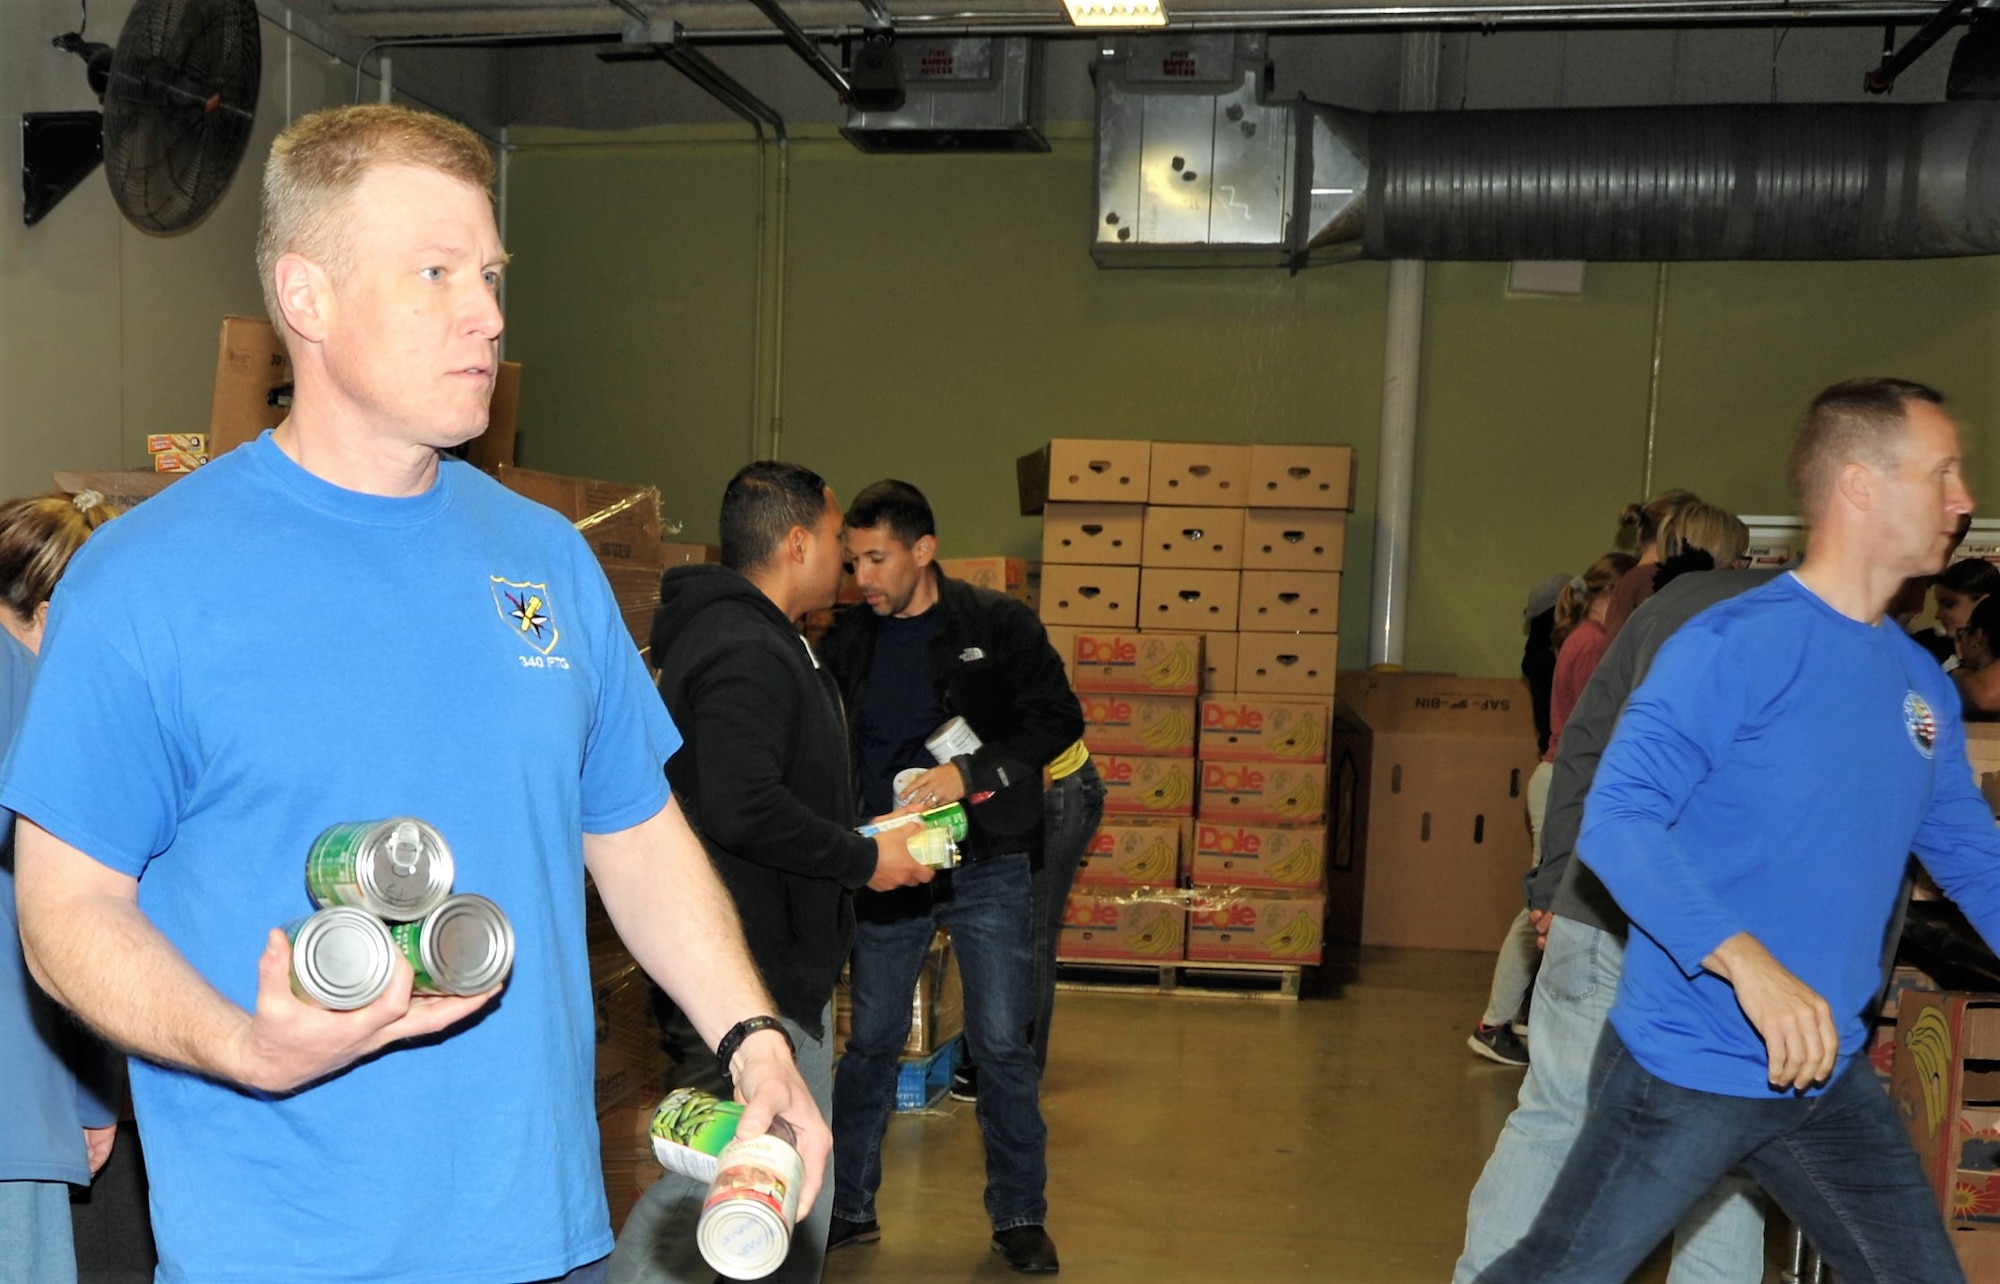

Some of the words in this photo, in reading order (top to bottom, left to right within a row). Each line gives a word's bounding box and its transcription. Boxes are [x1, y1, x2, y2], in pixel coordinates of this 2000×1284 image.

[518, 655, 544, 668] 340
[1078, 636, 1137, 662] Dole
[1202, 702, 1263, 728] Dole
[1203, 764, 1264, 790] Dole
[1198, 826, 1260, 853] Dole
